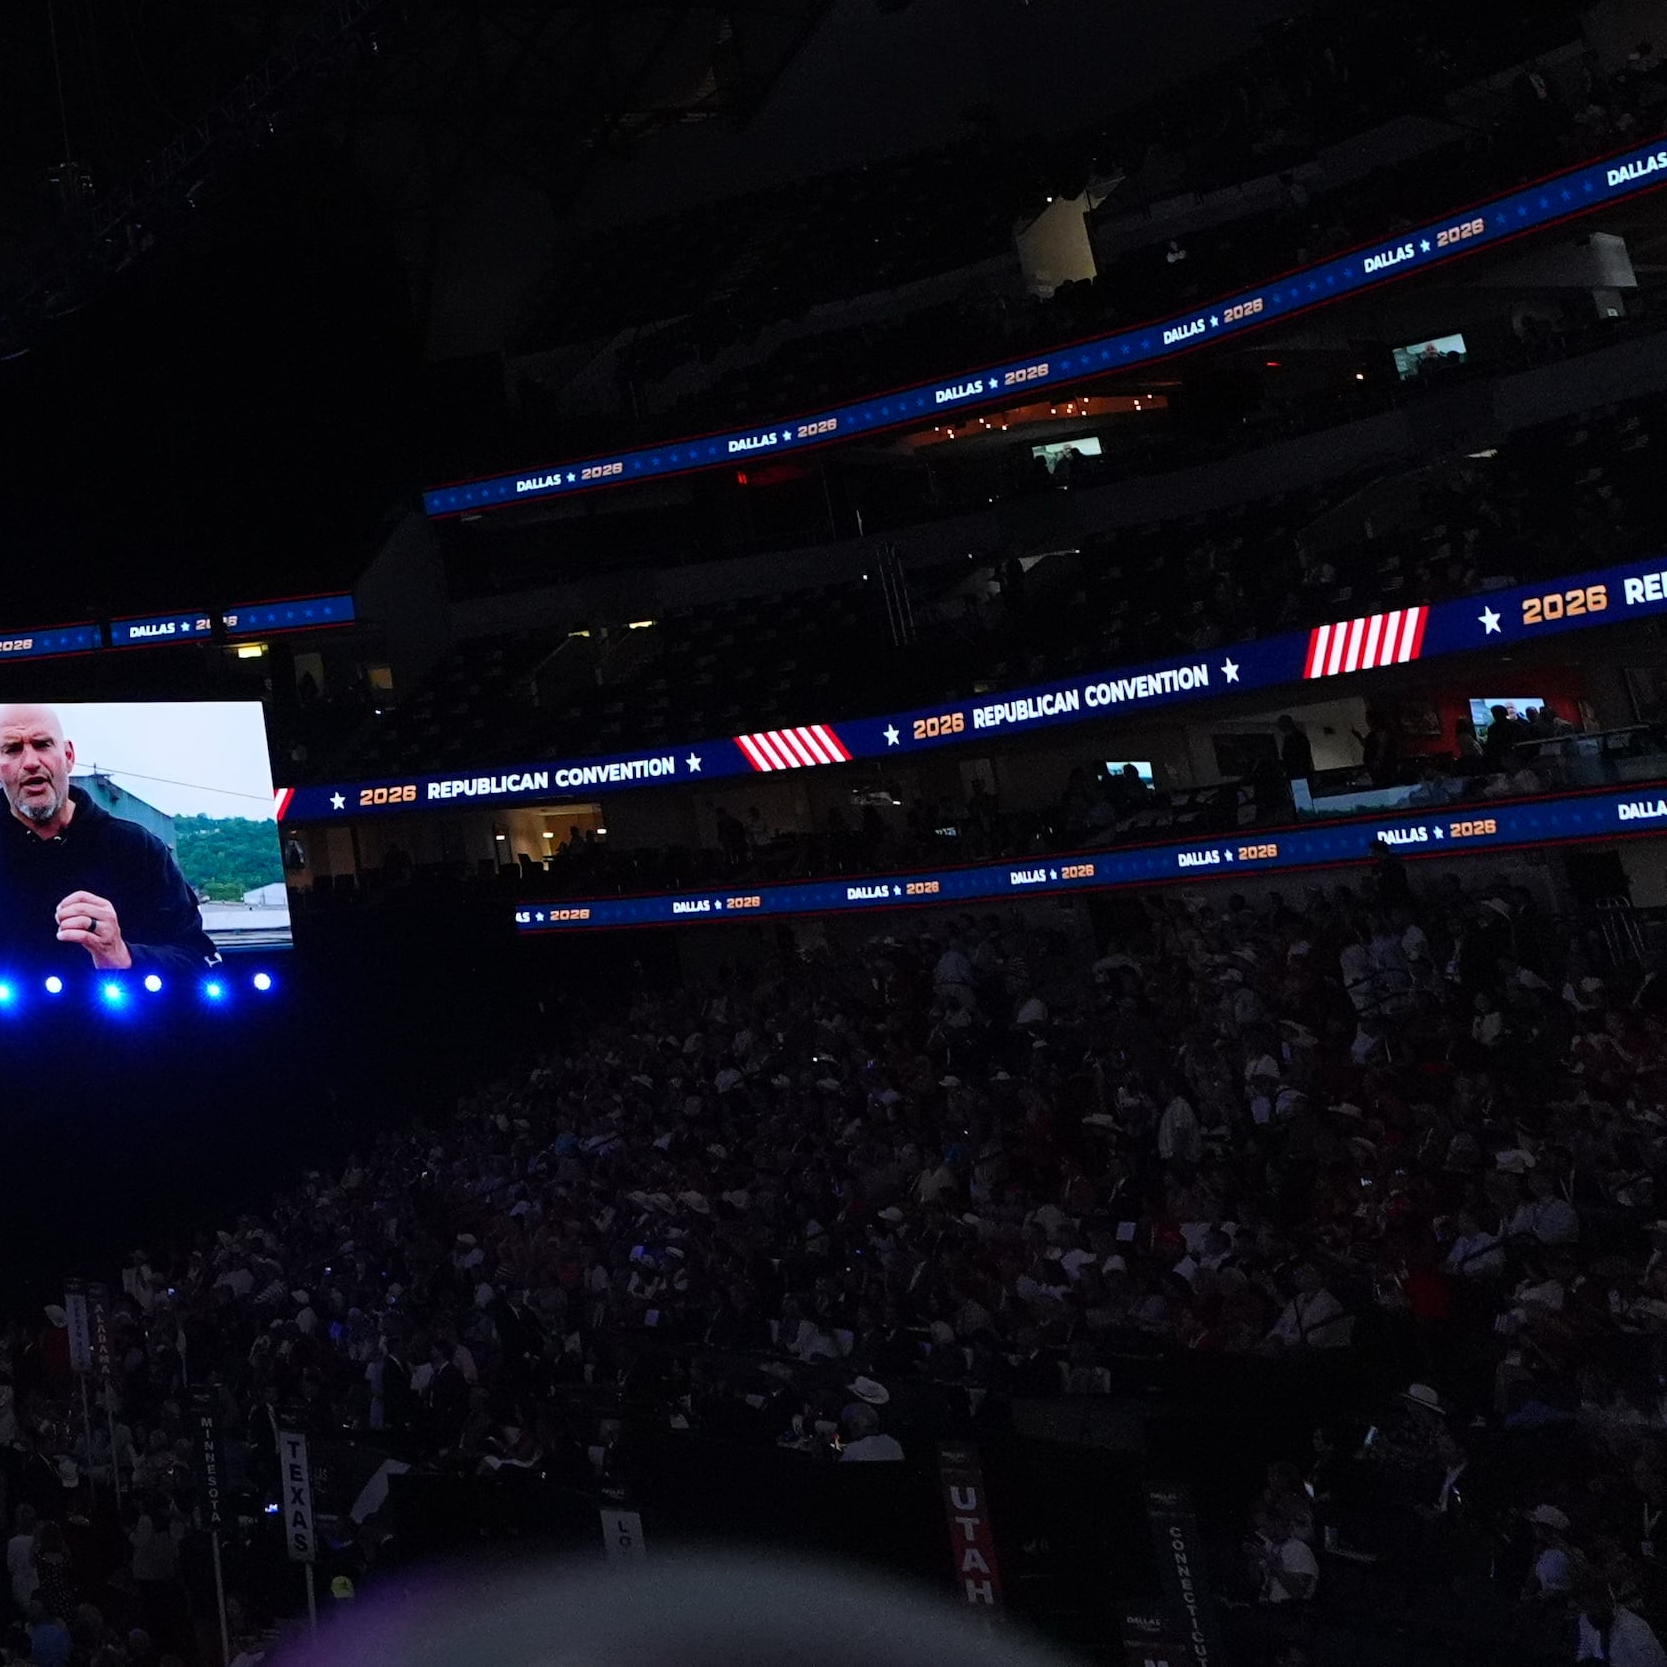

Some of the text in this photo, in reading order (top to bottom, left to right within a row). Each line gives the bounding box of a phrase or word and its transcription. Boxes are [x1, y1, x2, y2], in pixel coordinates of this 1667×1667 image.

[1607, 152, 1667, 187] DALLAS
[1364, 217, 1485, 273] DALLAS 2026
[1163, 298, 1264, 345] DALLAS 2026
[936, 363, 1050, 404] DALLAS 2026
[729, 418, 838, 453] DALLAS 2026
[516, 462, 623, 492] DALLAS 2026
[1521, 586, 1609, 626] 2026
[129, 622, 176, 638] DALLAS
[913, 664, 1210, 741] 2026 REPUBLICAN CONVENTION
[360, 756, 676, 807] 2026 REPUBLICAN CONVENTION
[1377, 818, 1497, 846] DALLAS 2026
[1010, 863, 1095, 885] DALLAS 2026
[1178, 844, 1278, 867] DALLAS 2026
[673, 896, 761, 914] DALLAS 2026
[847, 881, 940, 900] DALLAS 2026
[550, 909, 591, 921] 2026
[94, 1304, 110, 1374] ALABAMA
[200, 1417, 222, 1523] MINNESOTA
[287, 1440, 308, 1552] TEXAS
[949, 1485, 995, 1605] UTAH
[1169, 1525, 1208, 1667] CONNECTICUT
